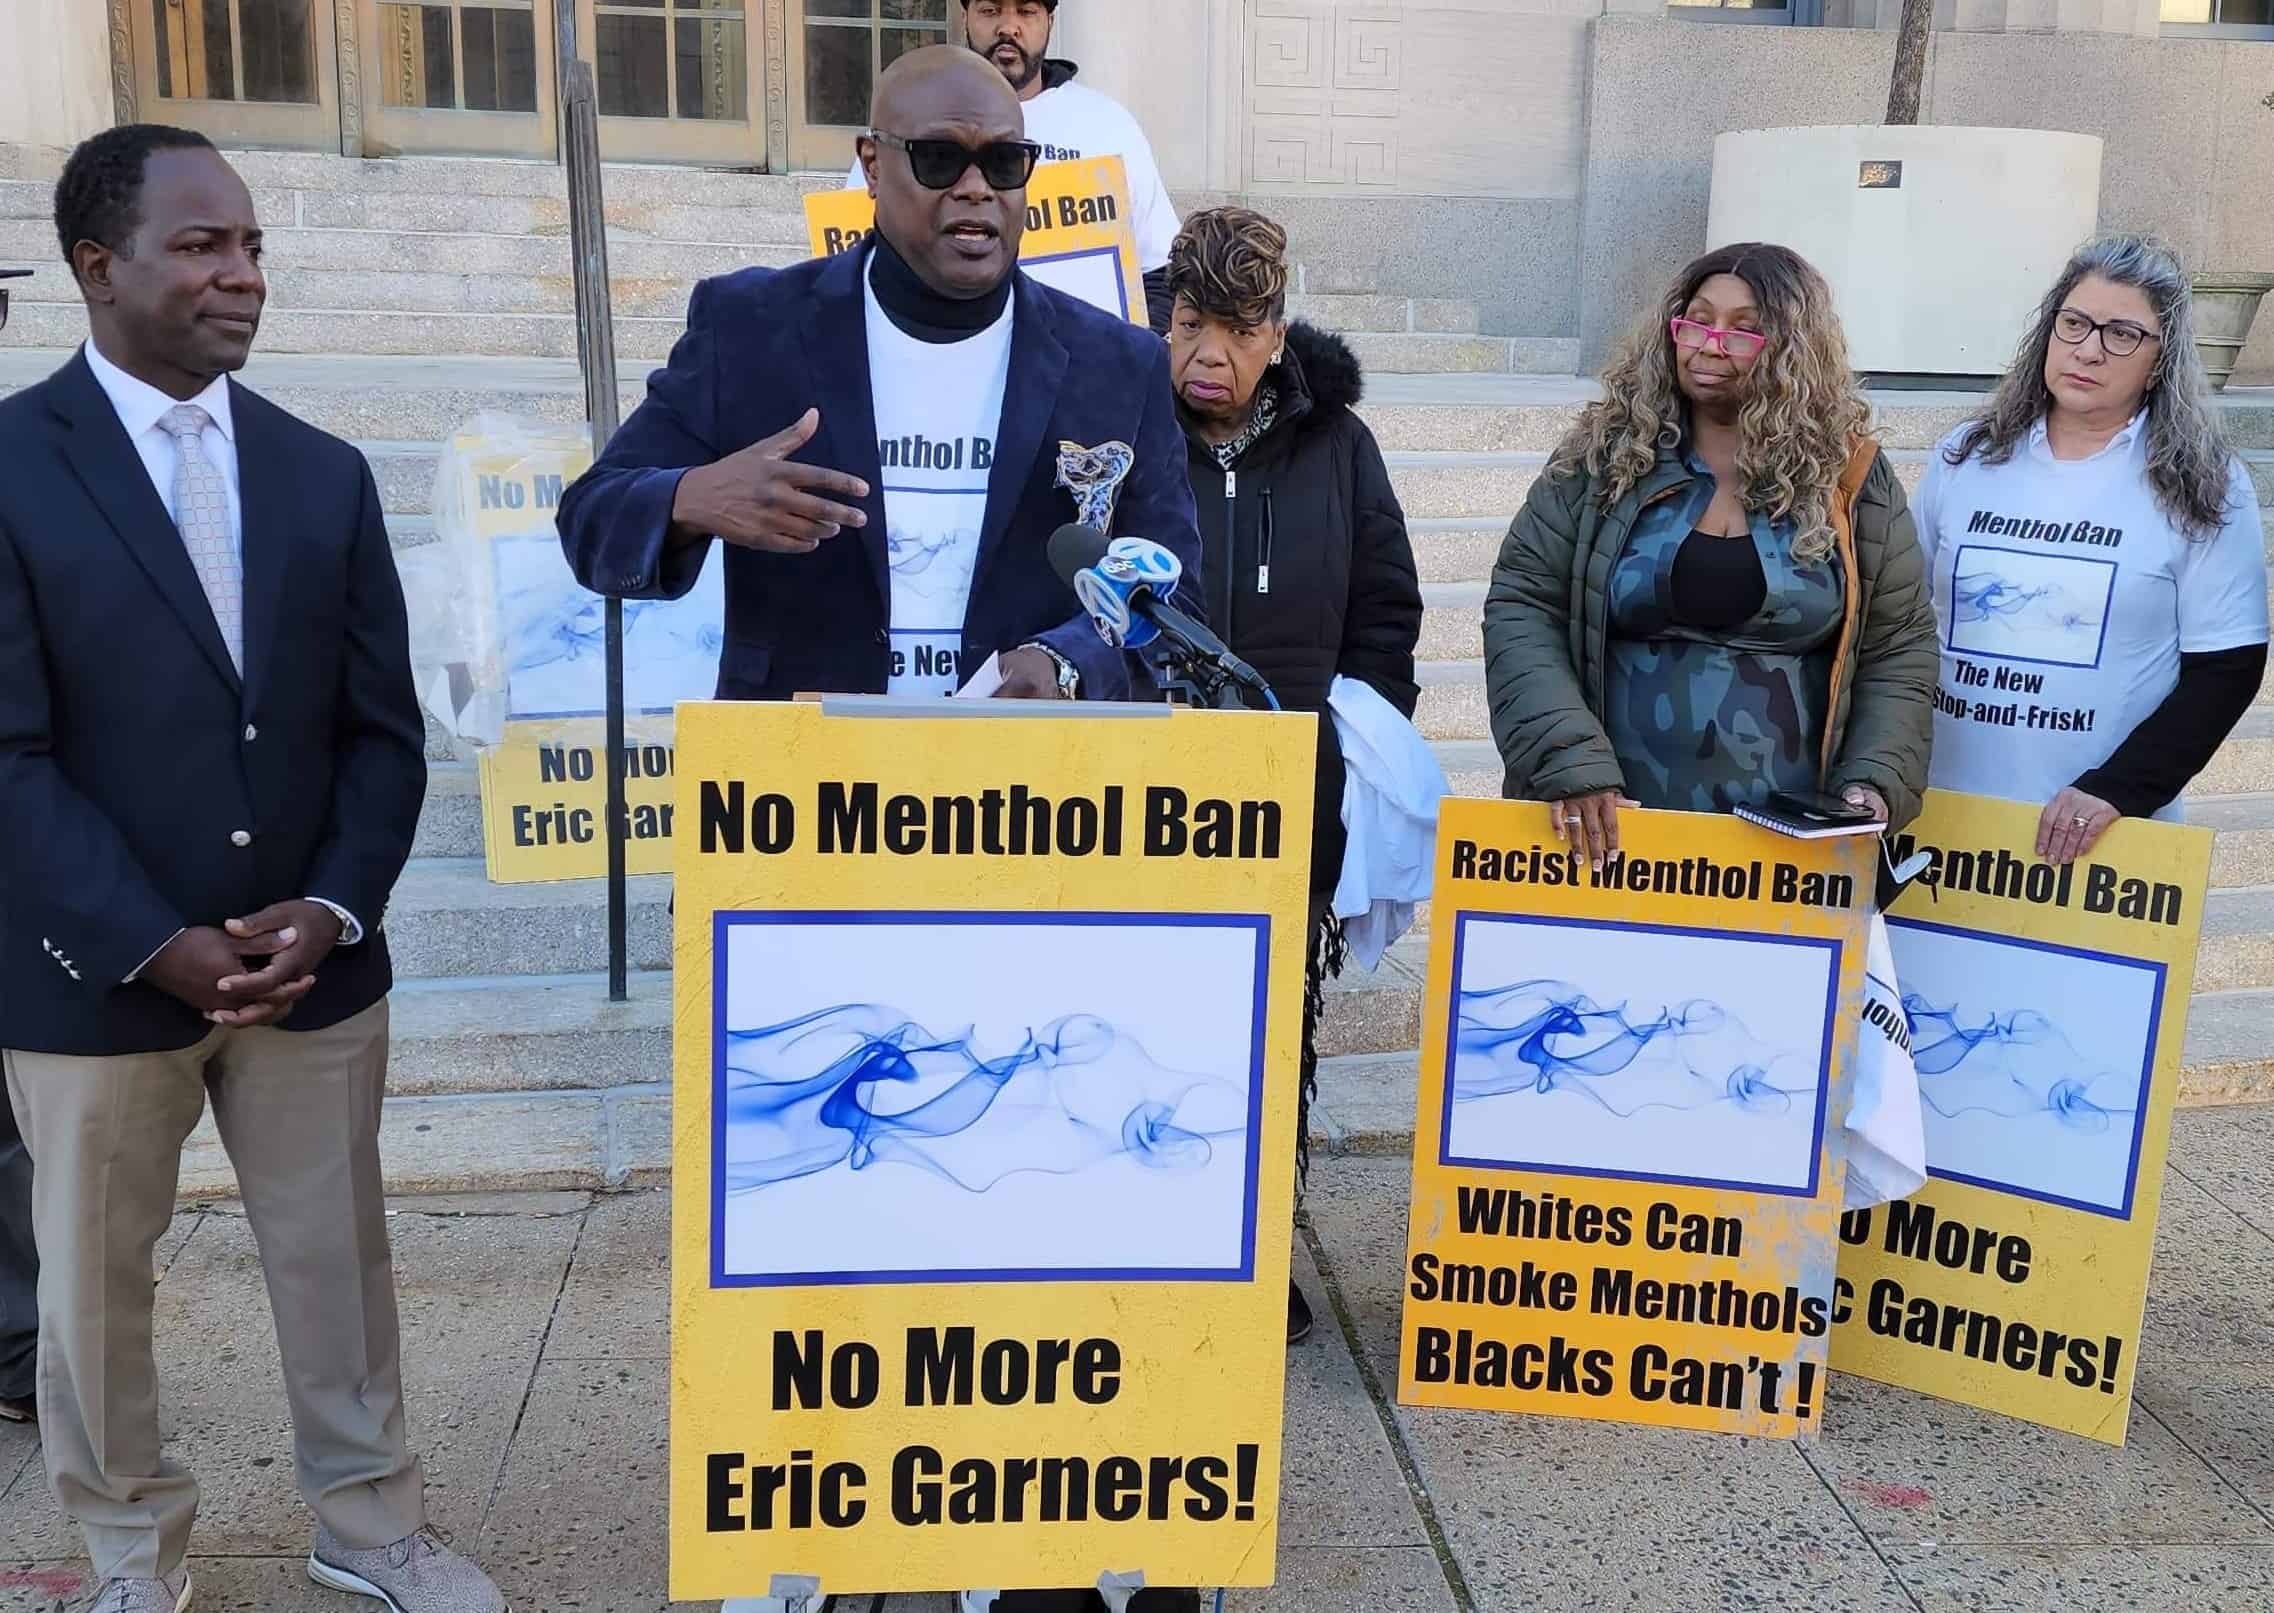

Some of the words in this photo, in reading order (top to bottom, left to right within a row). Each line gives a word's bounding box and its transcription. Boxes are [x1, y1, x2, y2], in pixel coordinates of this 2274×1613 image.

[1057, 195, 1116, 226] Ban
[880, 434, 963, 470] nthol
[479, 474, 525, 510] No
[1968, 511, 2072, 543] Menthol
[2071, 520, 2123, 548] Ban
[1954, 659, 1989, 688] The
[1993, 665, 2044, 694] New
[539, 741, 594, 783] No
[512, 803, 594, 847] Eric
[700, 780, 795, 855] No
[816, 781, 1124, 857] Menthol
[1143, 786, 1282, 859] Ban
[1452, 839, 1580, 887] Racist
[1590, 850, 1763, 902] Menthol
[1771, 864, 1855, 908] Ban
[2083, 863, 2183, 926] Ban
[1862, 998, 1914, 1060] nthol
[1456, 1186, 1633, 1247] Whites
[1645, 1202, 1744, 1257] Can
[1884, 1200, 2032, 1284] More
[1410, 1252, 1578, 1312] Smoke
[1590, 1266, 1829, 1337] Menthols
[771, 1329, 880, 1411] No
[904, 1326, 1122, 1407] More
[1414, 1326, 1614, 1397] Blacks
[1867, 1278, 2123, 1395] Garners!
[705, 1449, 867, 1533] Eric
[891, 1443, 1260, 1525] Garners!
